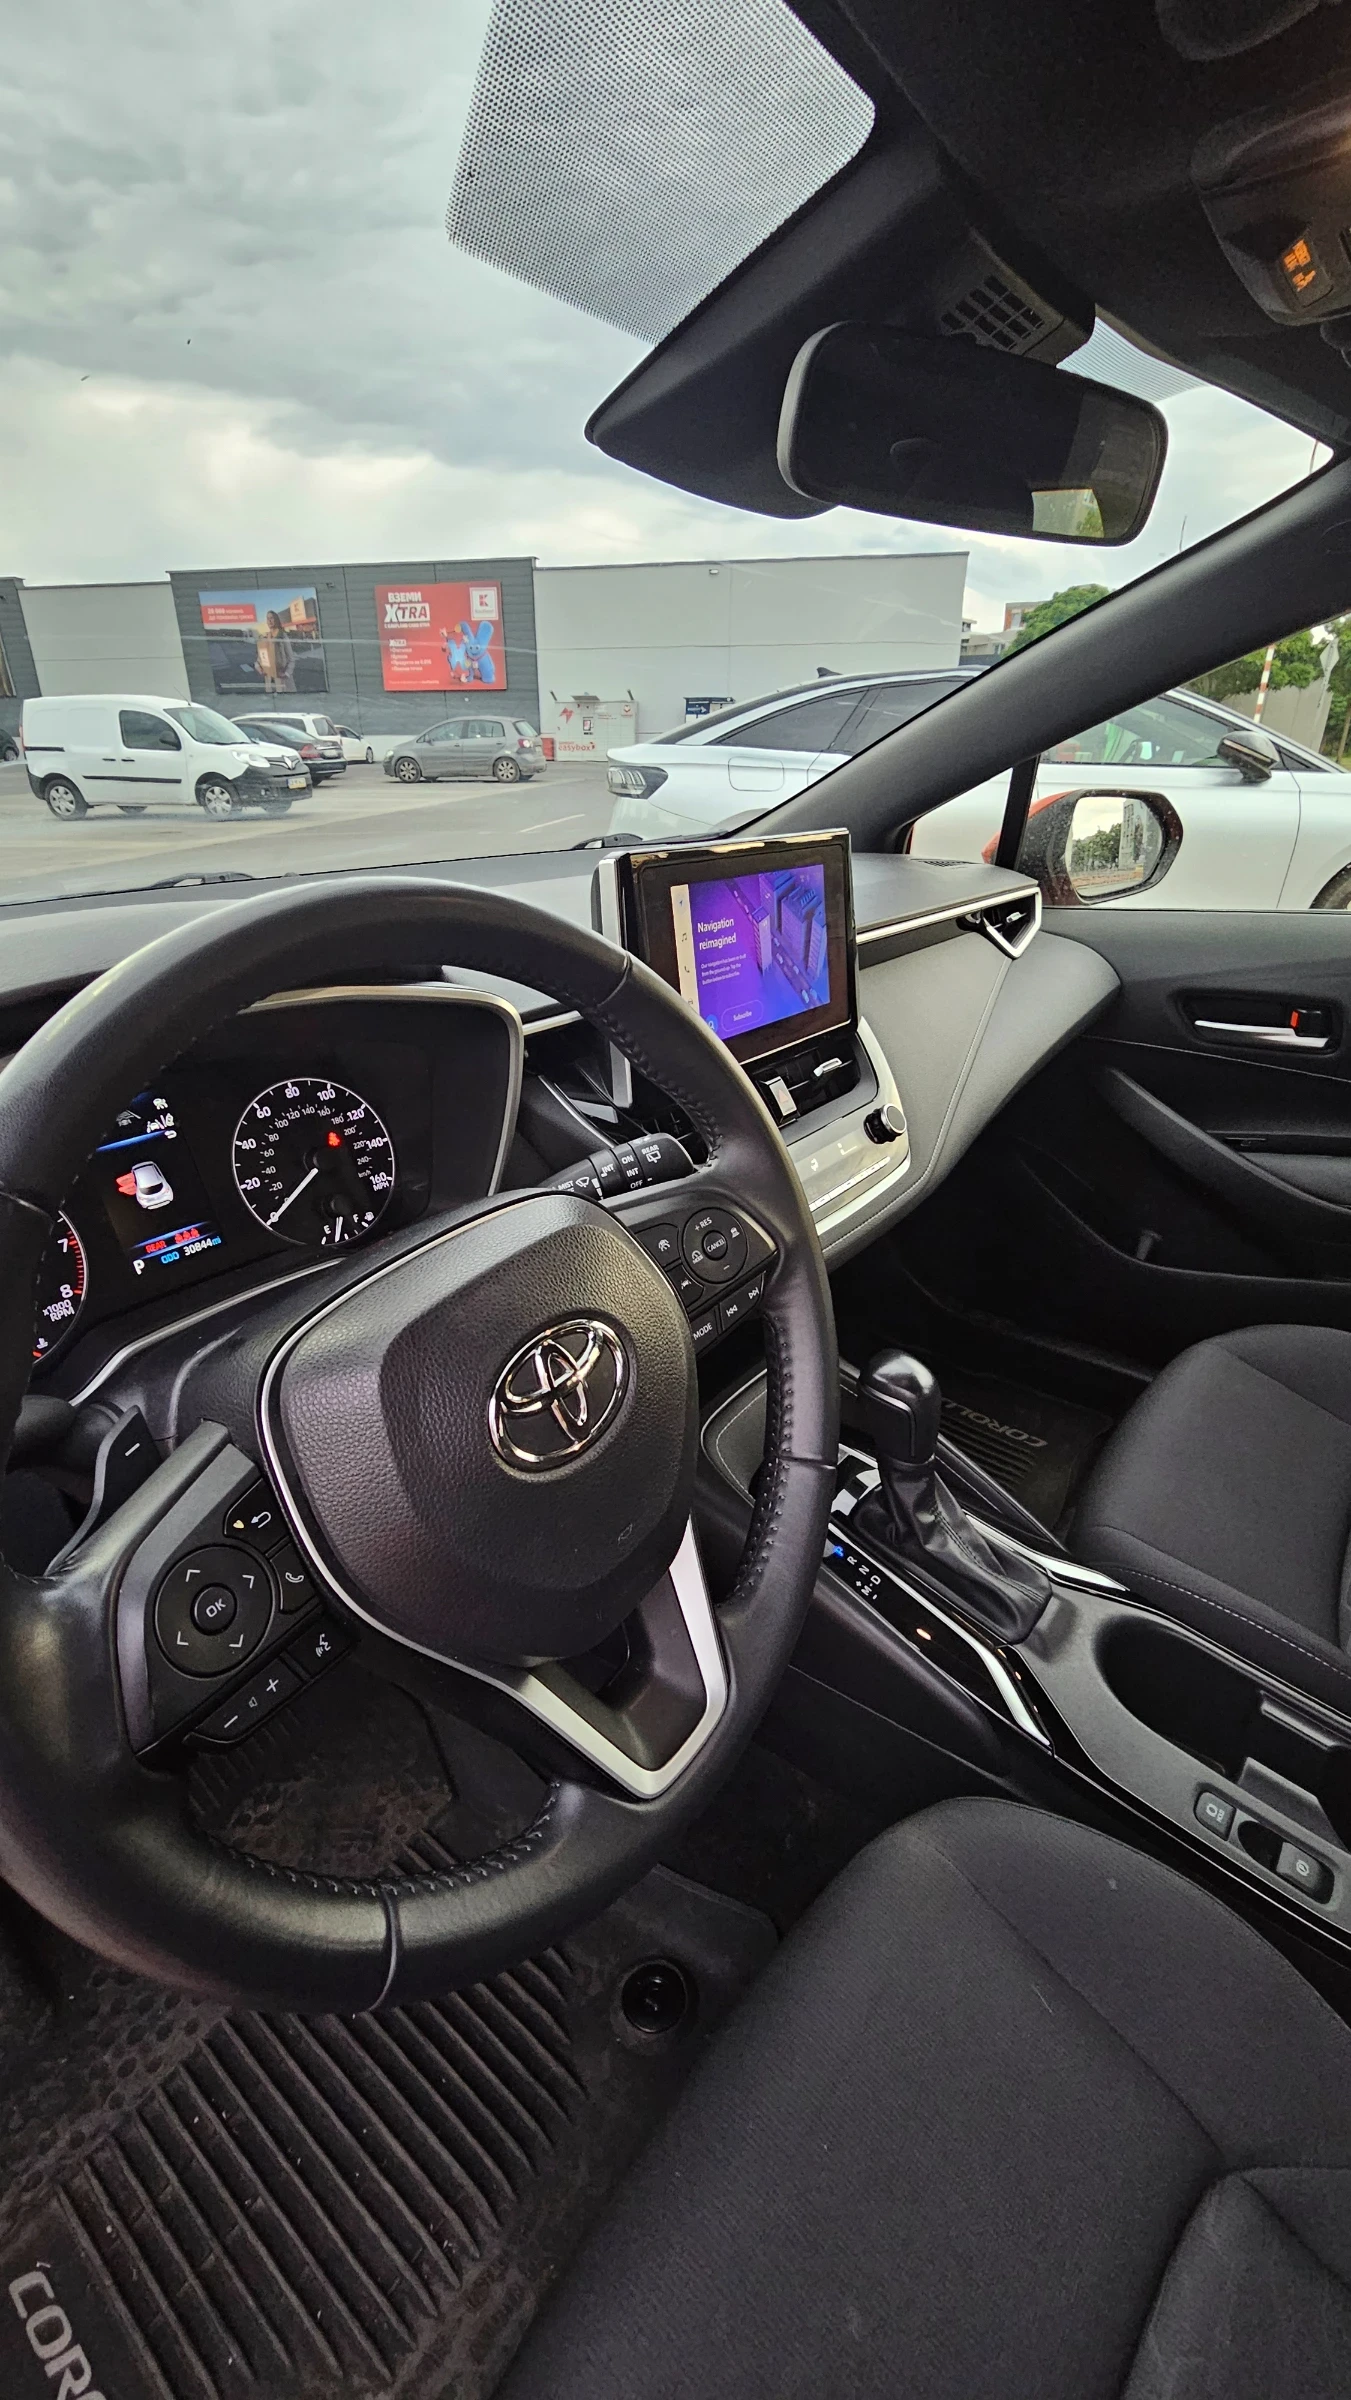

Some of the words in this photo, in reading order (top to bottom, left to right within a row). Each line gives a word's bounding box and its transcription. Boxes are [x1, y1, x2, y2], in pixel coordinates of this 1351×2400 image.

[387, 591, 422, 603] ВЗЕМИ
[384, 603, 429, 622] XTRA
[558, 743, 591, 752] easybox
[698, 918, 734, 933] Navigation
[699, 933, 736, 950] reimagined
[285, 1086, 300, 1099] 80
[317, 1088, 336, 1101] 100
[256, 1106, 271, 1119] 60
[286, 1110, 300, 1120] 120
[301, 1106, 315, 1116] 140
[317, 1107, 331, 1118] 160
[347, 1108, 365, 1121] 120
[274, 1119, 289, 1129] 100
[331, 1114, 344, 1125] 180
[241, 1138, 257, 1150] 40
[268, 1133, 280, 1142] 80
[366, 1137, 383, 1150] 140
[264, 1148, 275, 1157] 60
[641, 1144, 660, 1155] REAR
[621, 1155, 634, 1165] ON
[265, 1166, 277, 1175] 40
[626, 1168, 639, 1177] INT
[244, 1177, 261, 1191] 20
[369, 1172, 387, 1185] 160
[630, 1179, 643, 1189] OFF
[271, 1181, 283, 1191] 20
[373, 1180, 390, 1192] MPH
[352, 1213, 359, 1223] F
[323, 1225, 331, 1236] E
[57, 1238, 69, 1253] 7
[706, 1237, 726, 1253] CANCEL
[161, 1251, 180, 1264] ODO
[132, 1259, 145, 1275] P
[60, 1284, 74, 1299] 8
[42, 1299, 72, 1317] x1000
[50, 1306, 75, 1322] RPM
[693, 1322, 713, 1340] MODE
[942, 1397, 1048, 1447] COROLL
[846, 1555, 858, 1566] R
[858, 1564, 870, 1575] N
[870, 1575, 882, 1586] D
[860, 1583, 873, 1596] M
[205, 1598, 227, 1618] OK
